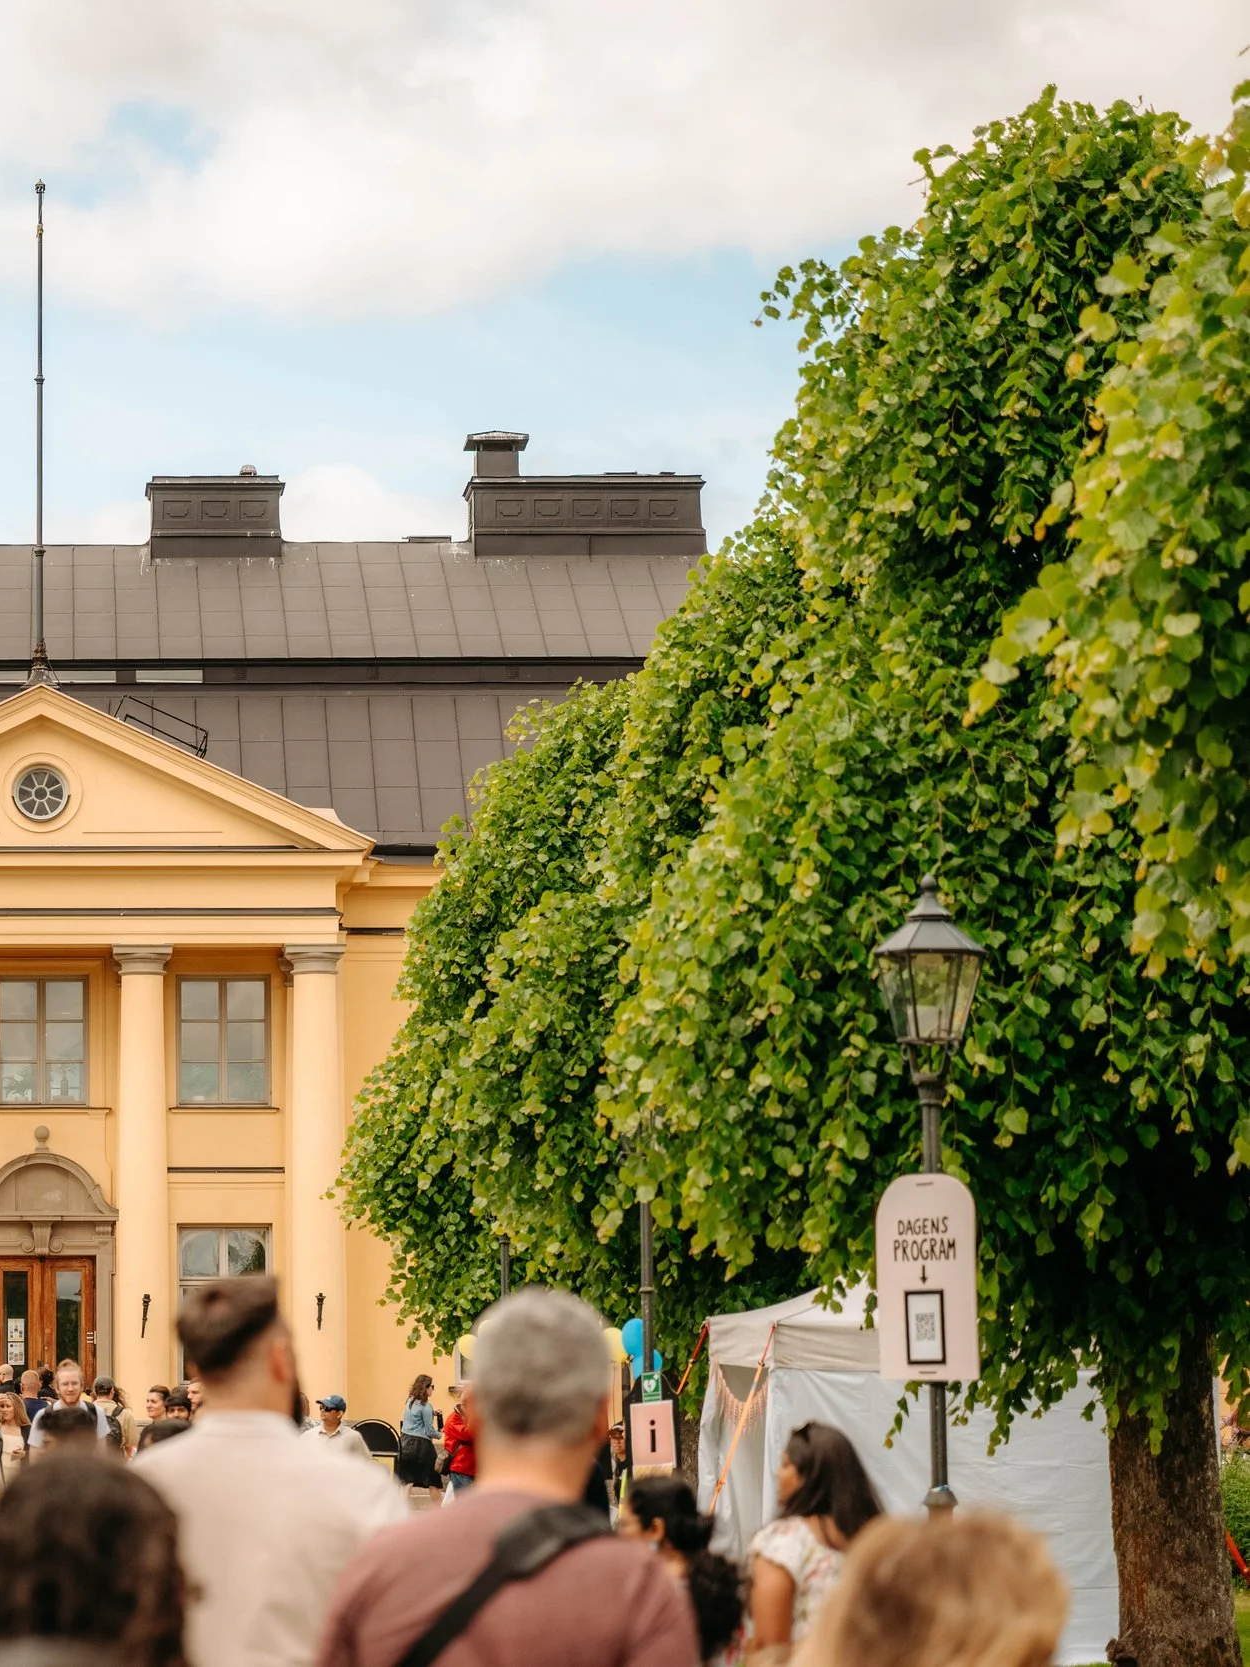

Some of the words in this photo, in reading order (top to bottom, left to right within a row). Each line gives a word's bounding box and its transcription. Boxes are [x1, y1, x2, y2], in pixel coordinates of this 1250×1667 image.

[897, 1216, 949, 1235] DAGENS
[893, 1237, 956, 1262] PROGRAM
[649, 1419, 657, 1454] i
